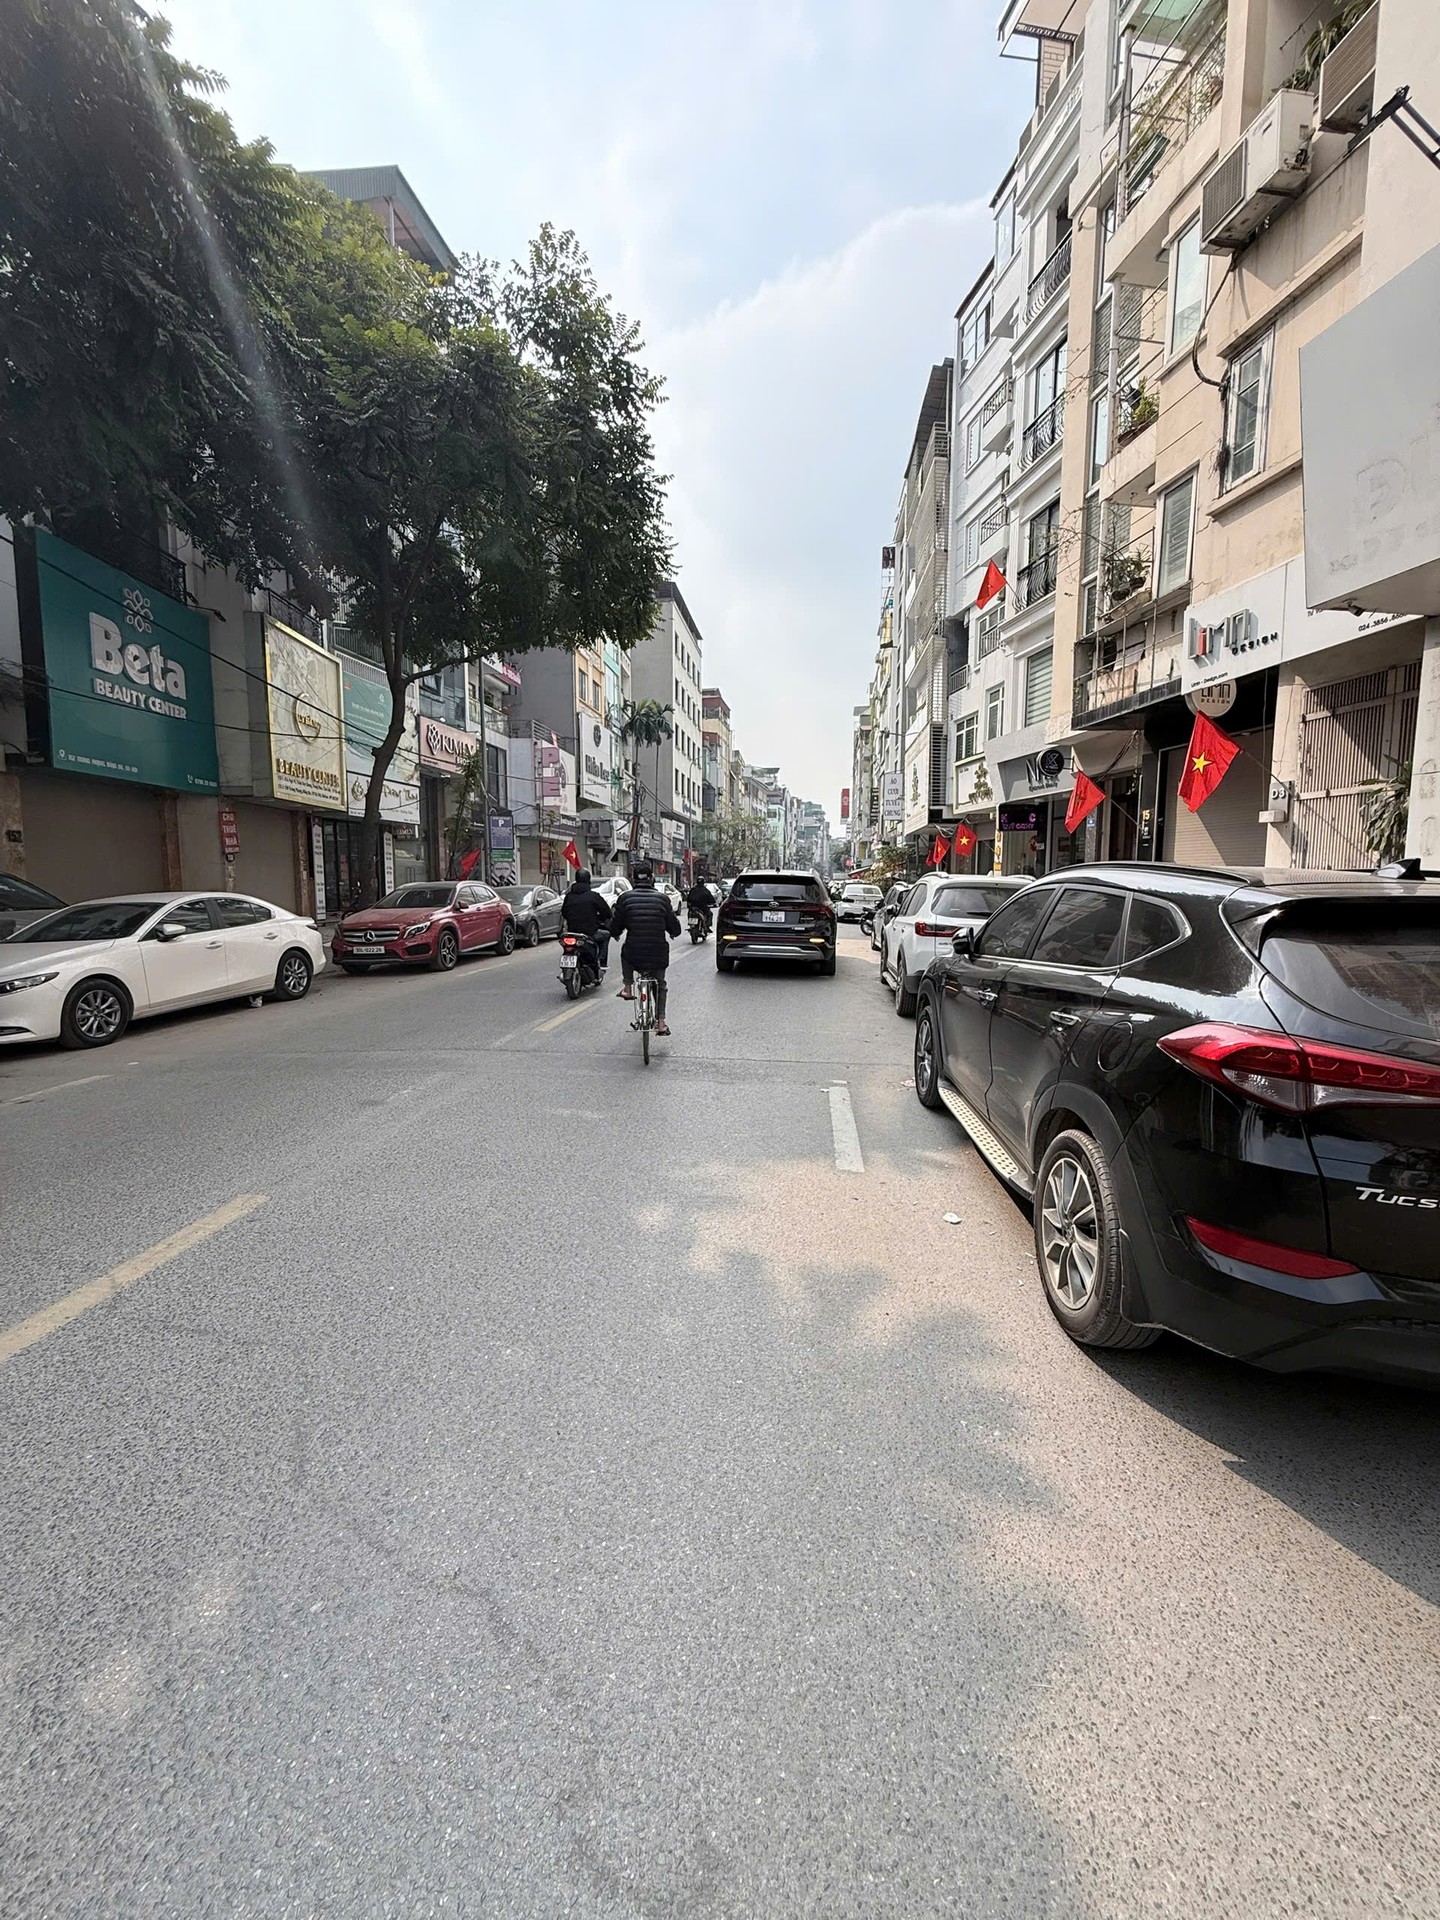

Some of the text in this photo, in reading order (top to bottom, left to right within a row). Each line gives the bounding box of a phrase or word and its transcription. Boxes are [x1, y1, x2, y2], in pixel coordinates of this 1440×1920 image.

[1232, 632, 1278, 656] DESIGN
[89, 612, 187, 700] Beta
[95, 678, 187, 719] BEAUTY CENTER
[276, 758, 311, 780] BEAUTY
[1272, 788, 1286, 799] D3
[1142, 810, 1151, 820] 15
